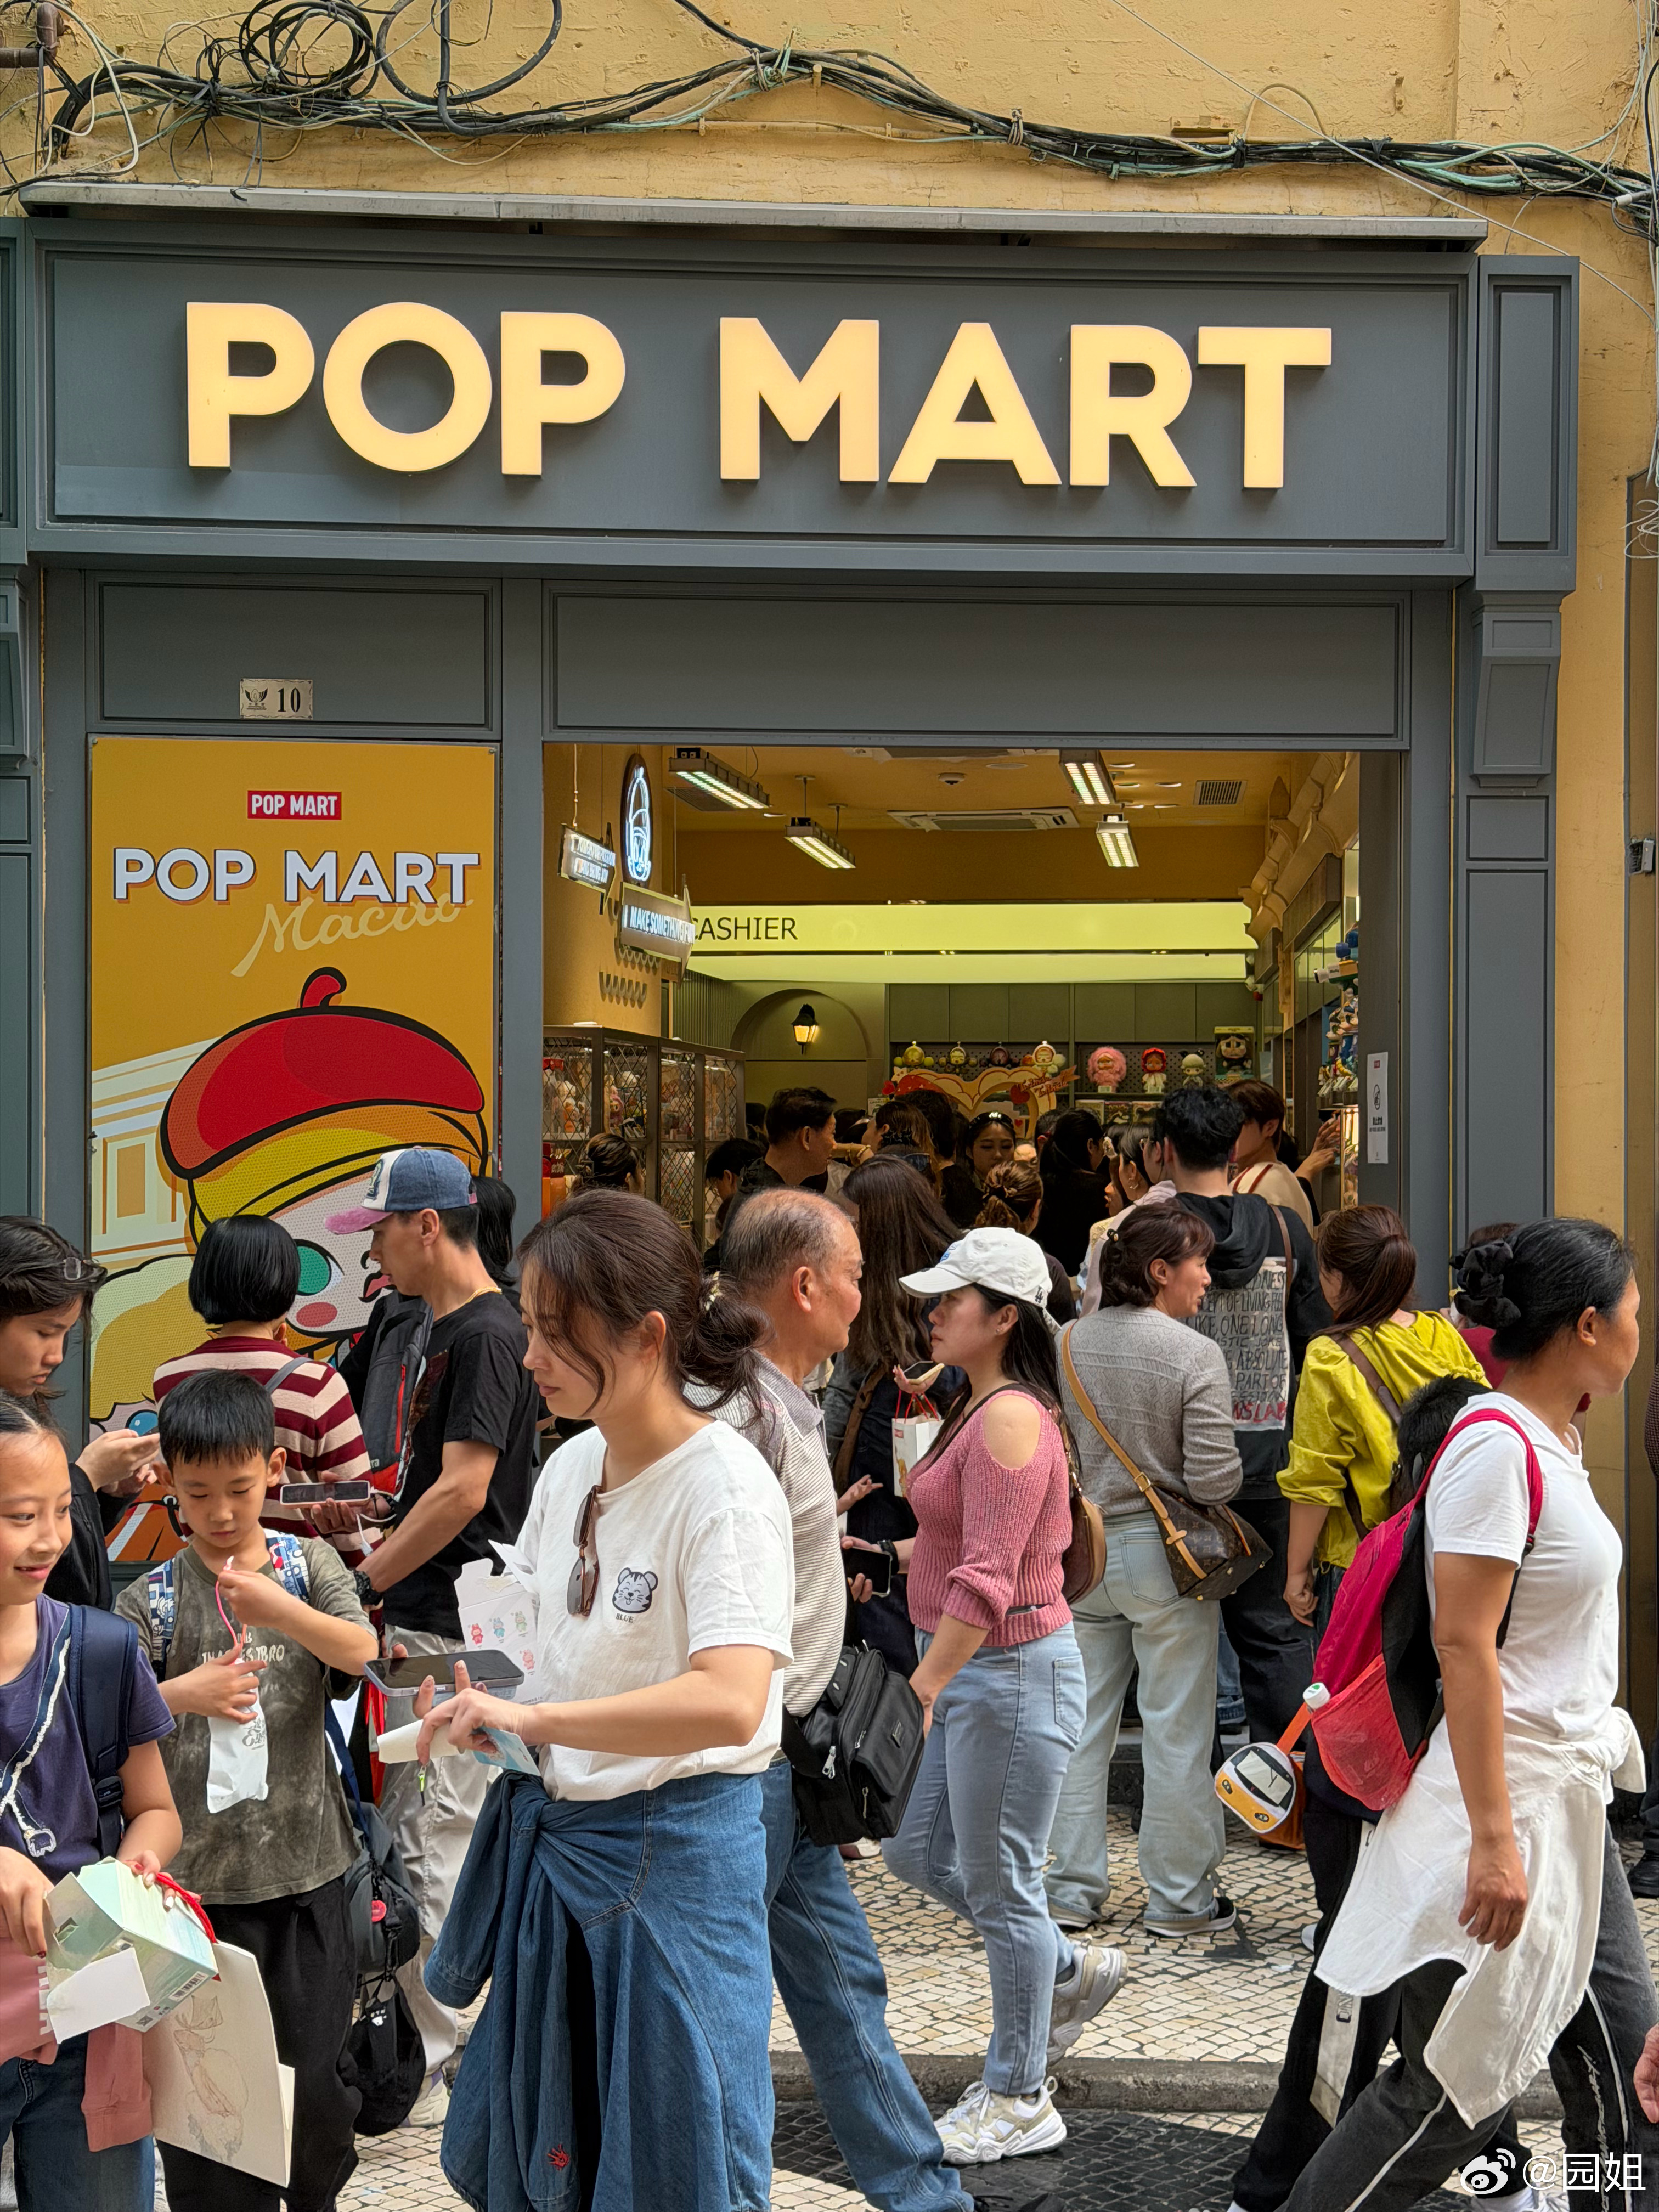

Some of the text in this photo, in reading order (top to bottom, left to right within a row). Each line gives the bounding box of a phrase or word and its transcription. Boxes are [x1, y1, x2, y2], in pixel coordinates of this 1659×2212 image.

[185, 301, 1333, 490] POP MART
[278, 687, 301, 713] 10
[252, 794, 338, 816] POP MART
[114, 847, 481, 905] POP MART
[230, 896, 475, 978] Macao
[1235, 1372, 1269, 1391] PART
[616, 1613, 634, 1623] BLUE
